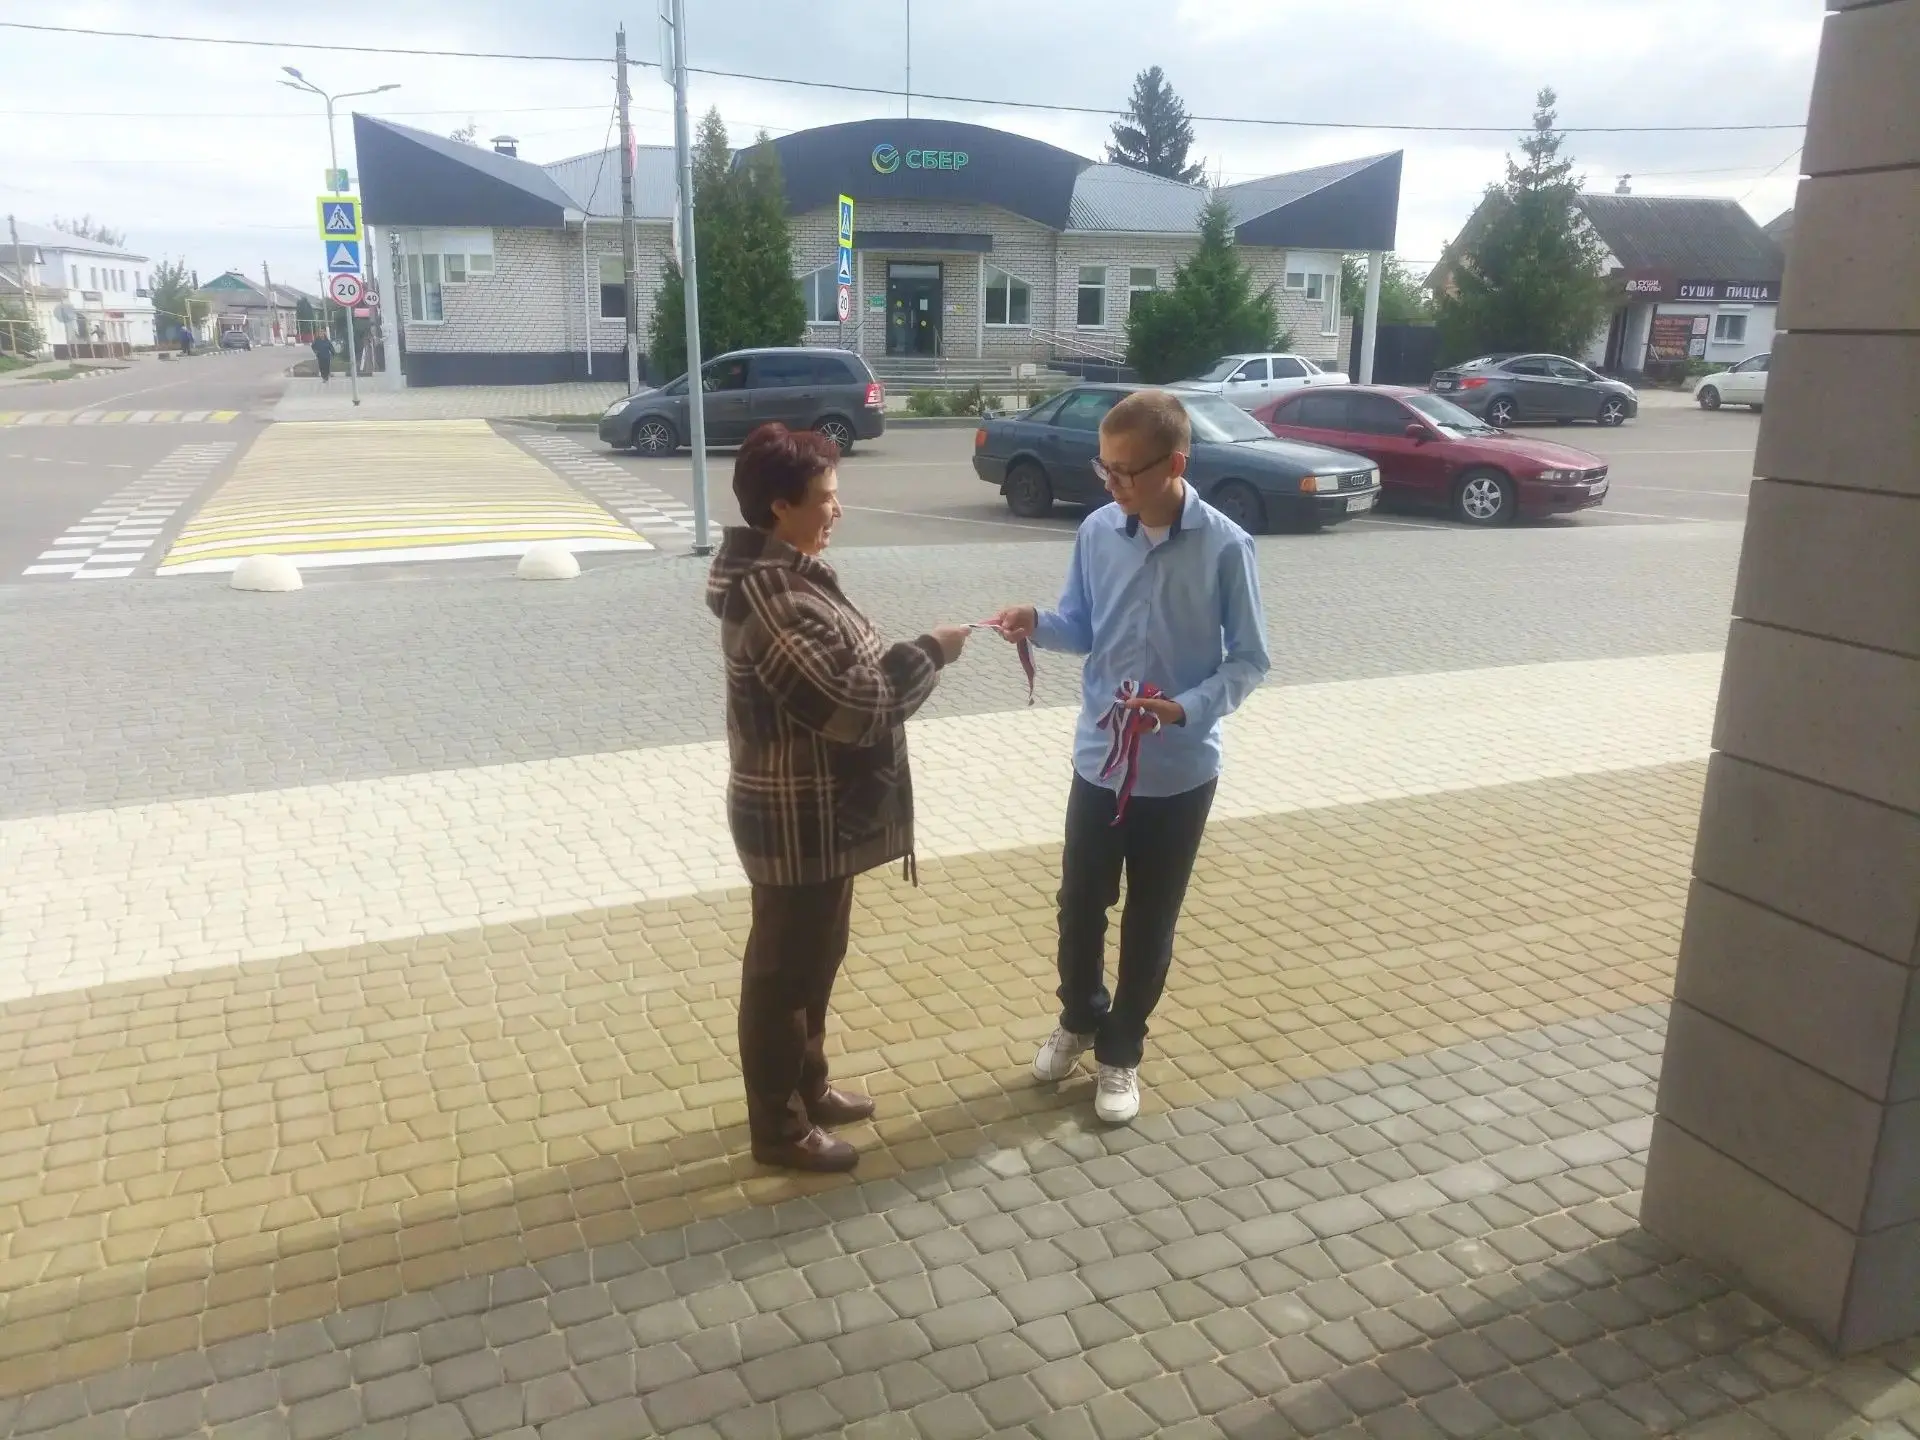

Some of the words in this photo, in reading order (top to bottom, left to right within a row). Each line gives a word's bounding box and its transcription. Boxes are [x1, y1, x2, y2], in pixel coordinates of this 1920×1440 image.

[905, 149, 969, 170] СБЕР
[337, 284, 356, 296] 20
[1680, 285, 1714, 297] СУШИ
[1726, 286, 1769, 299] ПИЦЦА
[840, 295, 848, 310] 20
